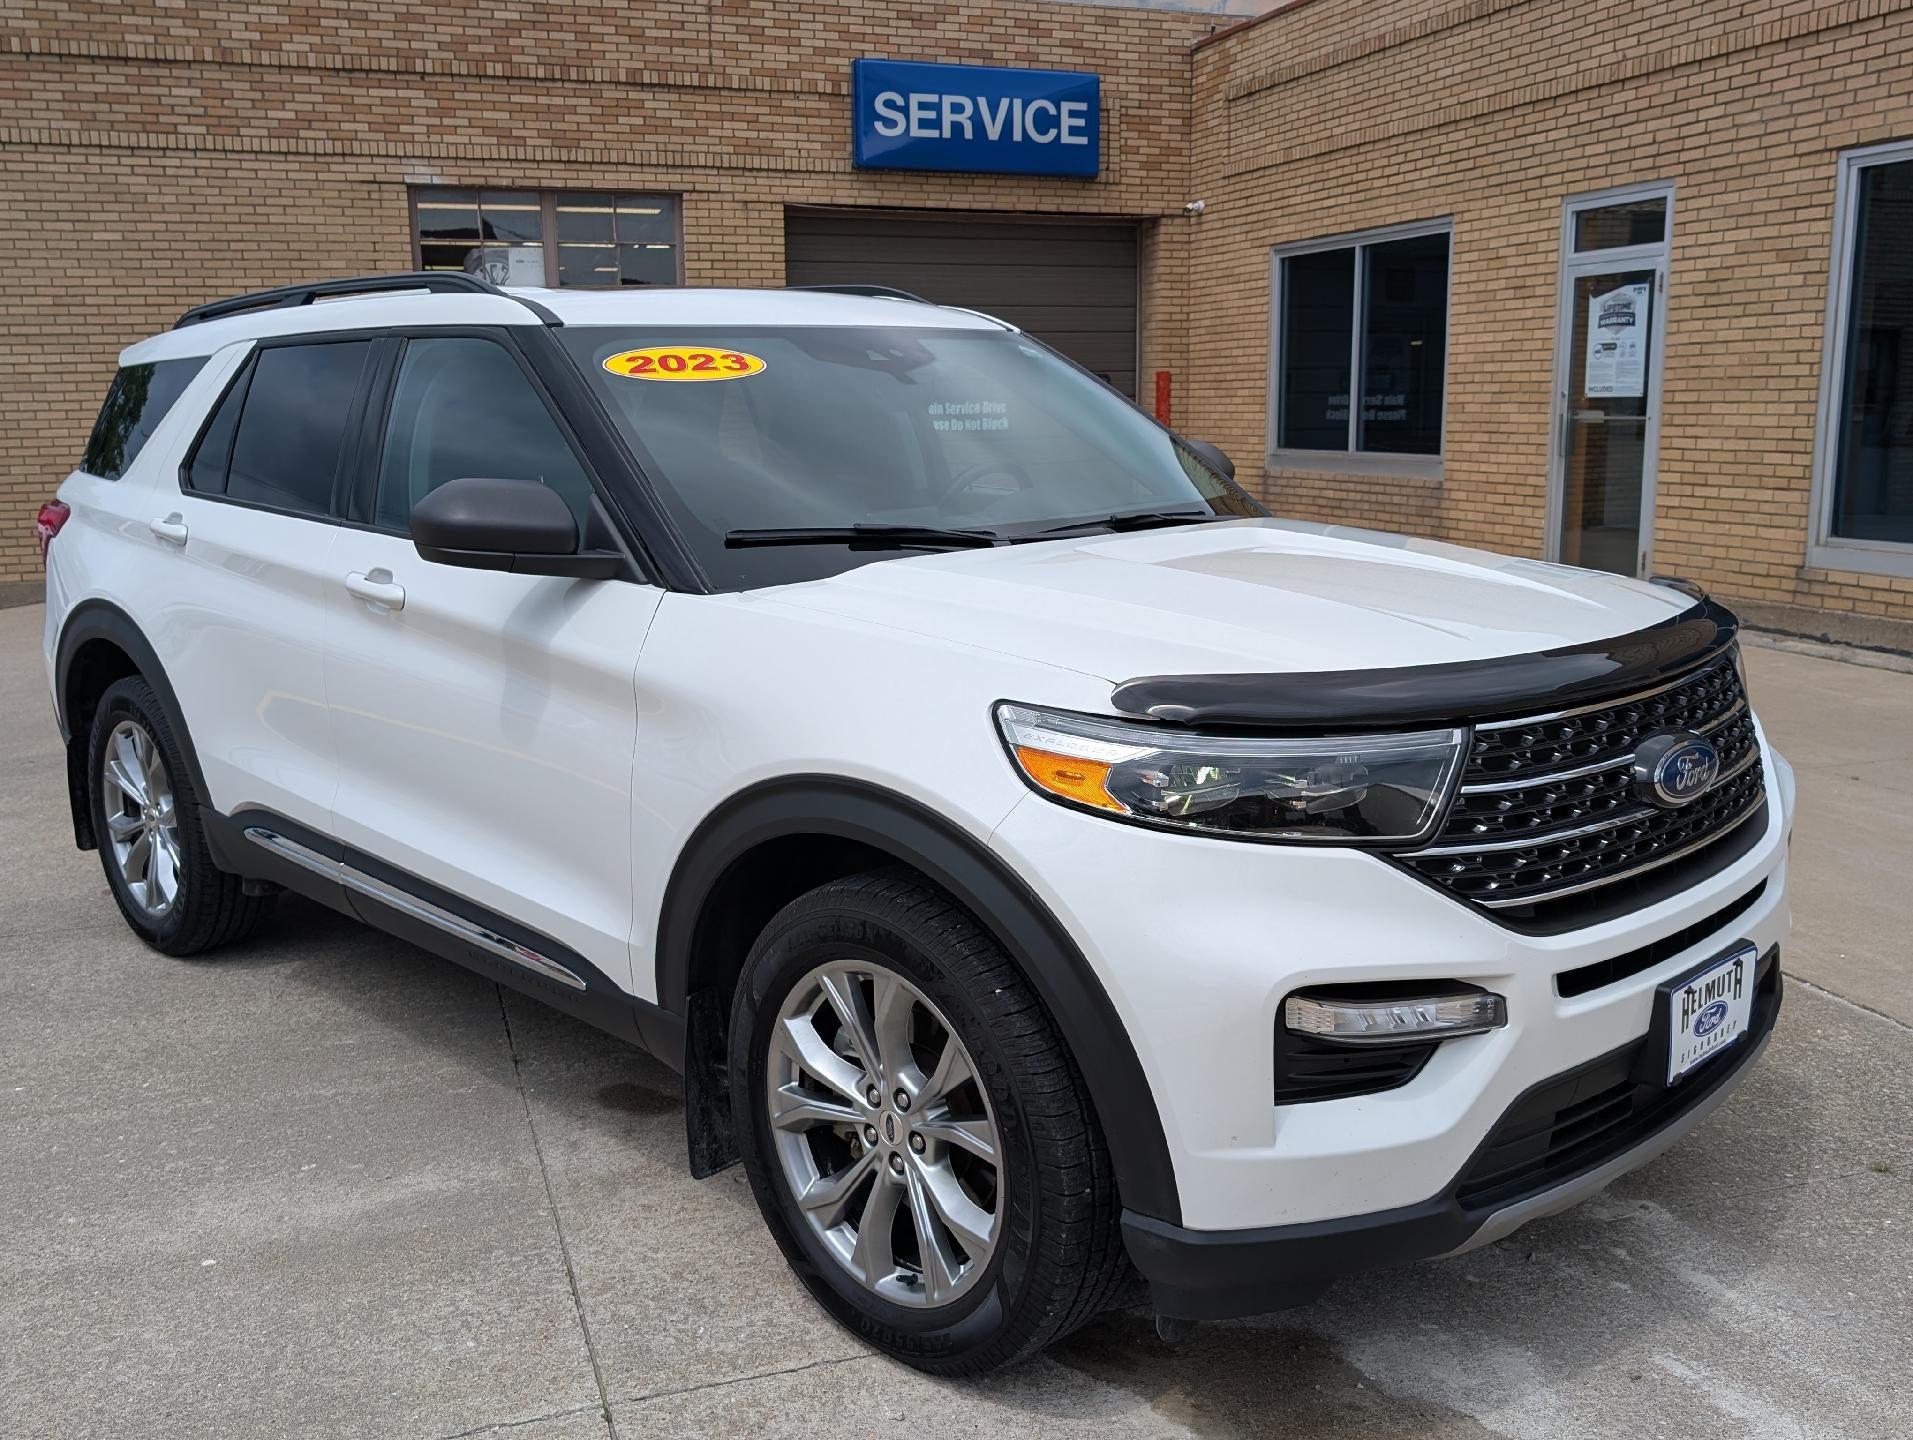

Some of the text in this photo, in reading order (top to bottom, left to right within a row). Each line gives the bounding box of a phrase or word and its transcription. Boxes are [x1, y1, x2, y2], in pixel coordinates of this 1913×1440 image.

[873, 91, 1089, 144] SERVICE
[1600, 316, 1634, 326] WARRANTY
[626, 354, 751, 374] 2023
[1676, 751, 1711, 792] Ford
[1681, 960, 1744, 1035] HELMUTH
[1698, 1005, 1724, 1034] Ford
